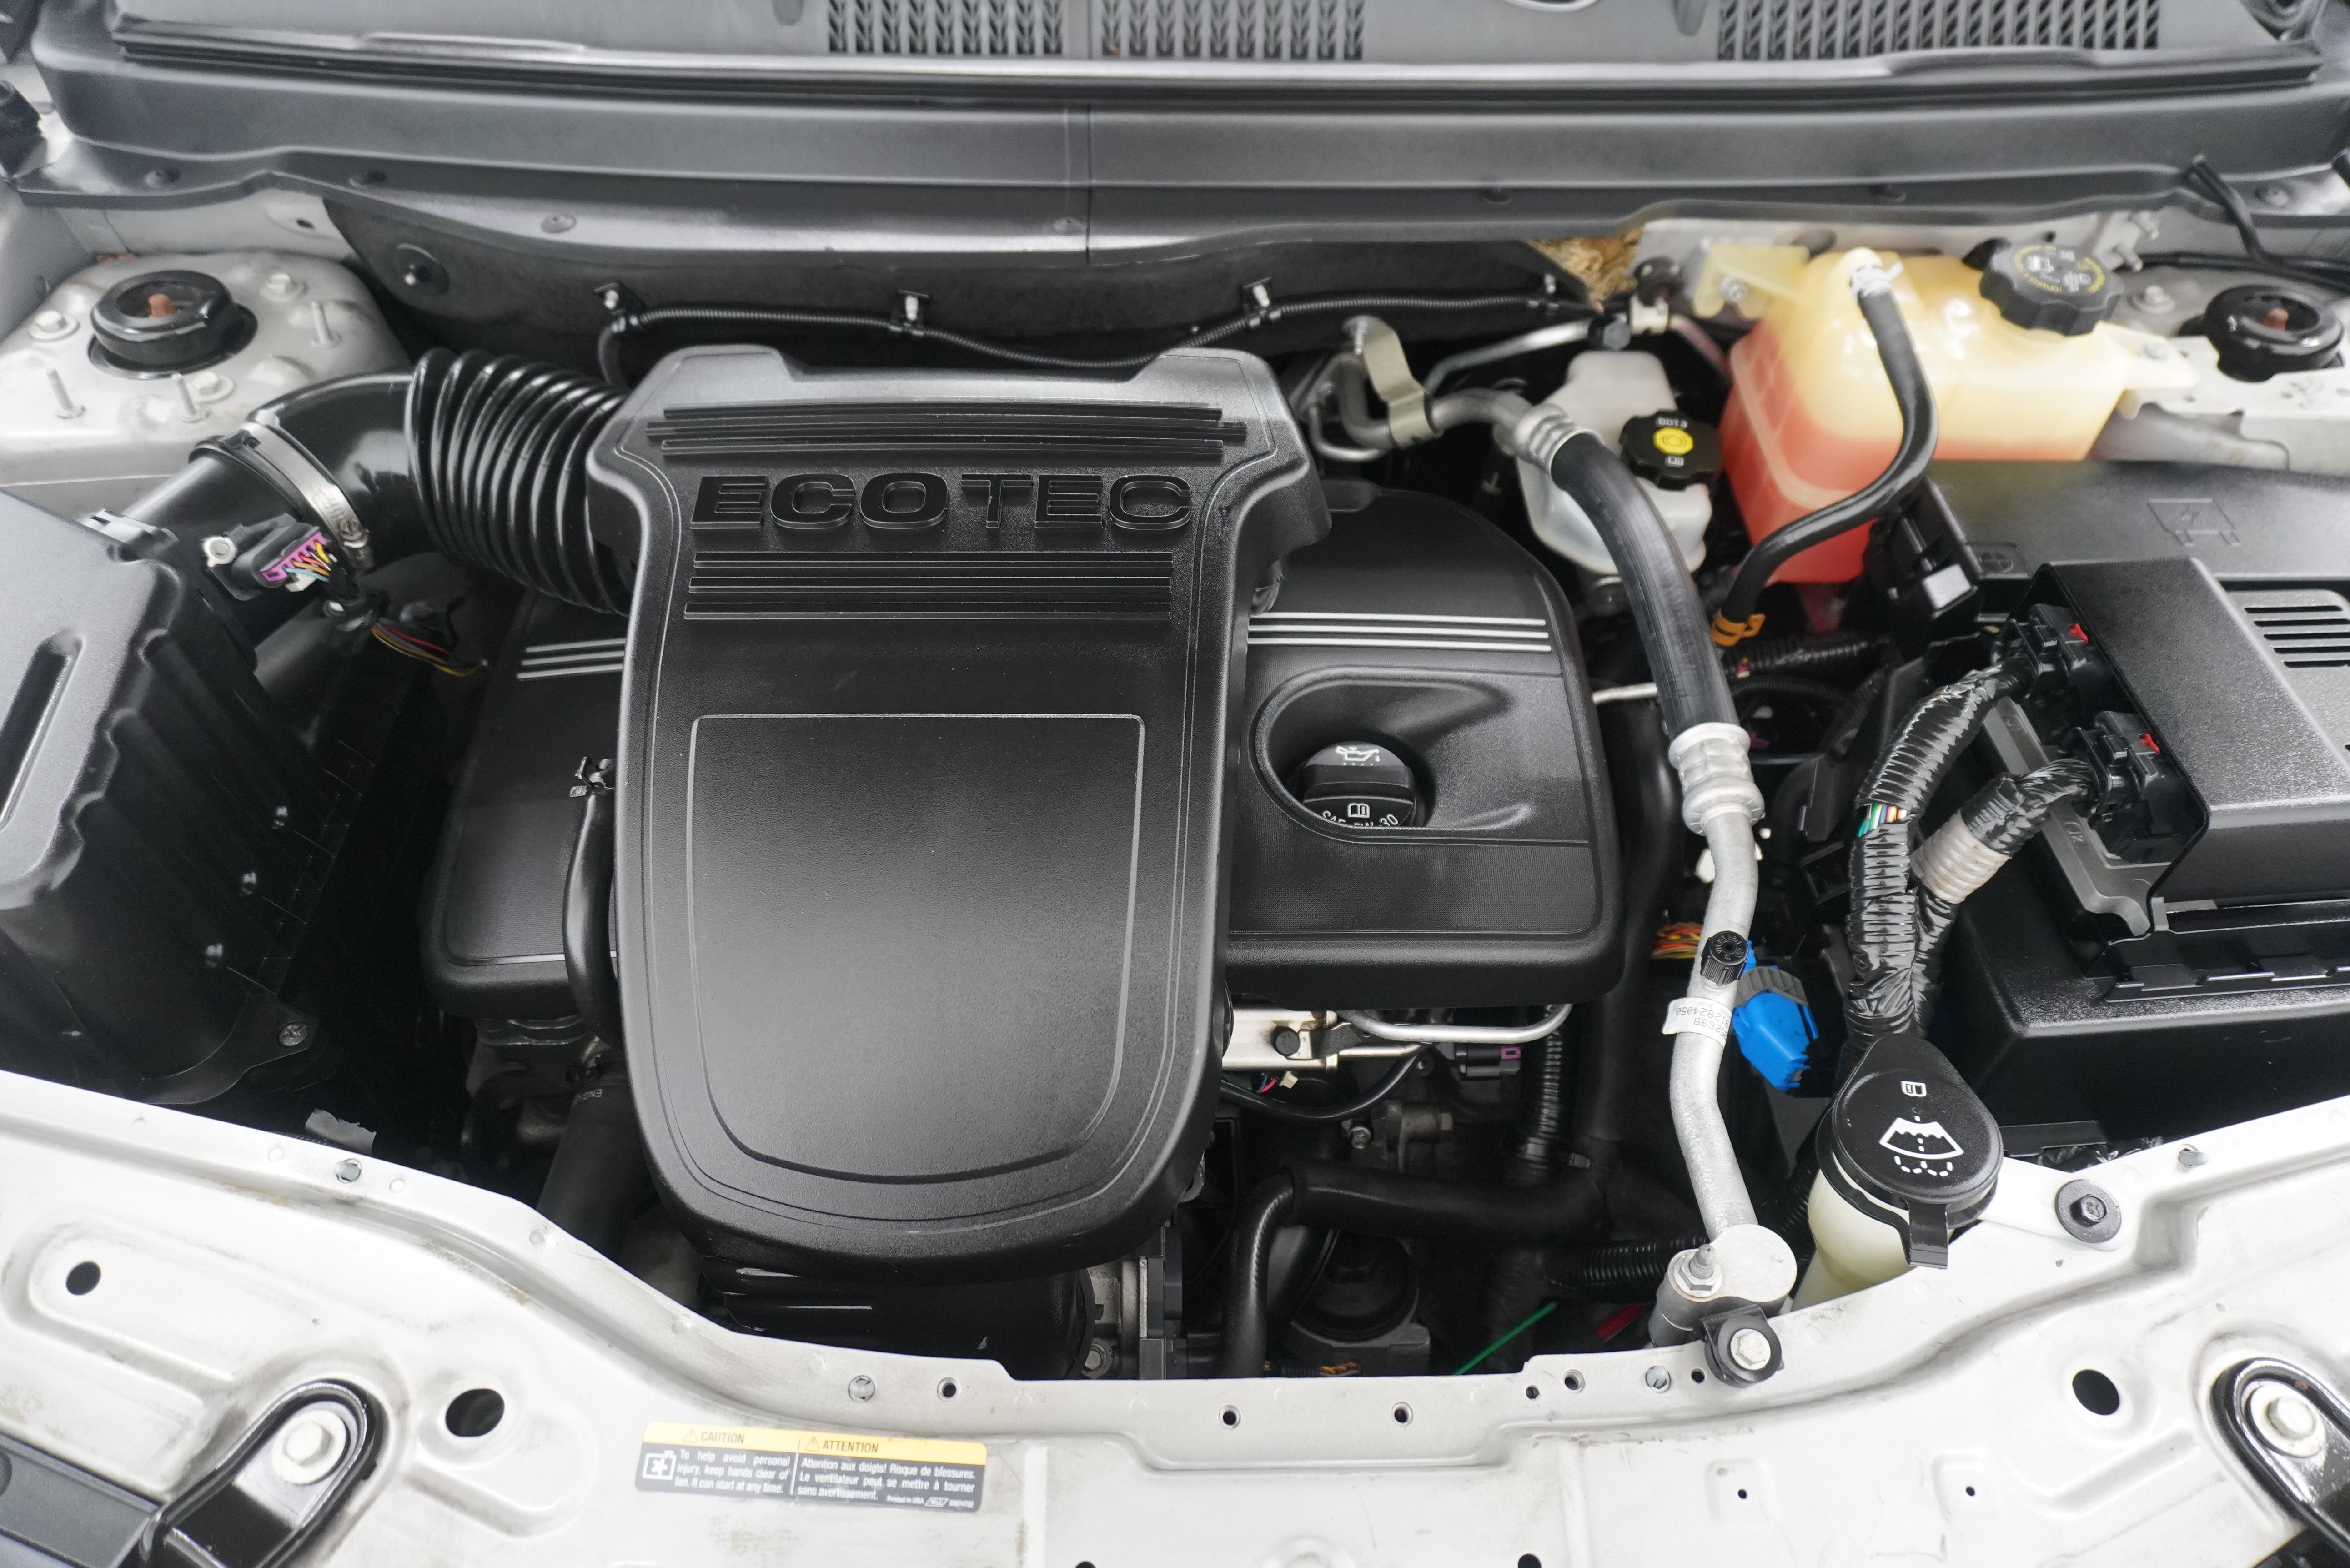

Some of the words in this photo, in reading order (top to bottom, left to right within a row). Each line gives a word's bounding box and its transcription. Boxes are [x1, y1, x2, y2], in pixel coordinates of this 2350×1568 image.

[690, 472, 1193, 531] ECOTEC
[701, 1431, 745, 1444] CAUTION
[823, 1440, 879, 1453] ATTENTION
[680, 1448, 690, 1460] To
[697, 1450, 715, 1463] help
[723, 1452, 747, 1464] avoid
[753, 1455, 790, 1467] personal
[677, 1462, 701, 1476] injury,
[704, 1464, 725, 1478] keep
[728, 1466, 753, 1478] hands
[755, 1468, 777, 1479] clear
[778, 1468, 790, 1480] of
[802, 1457, 838, 1470] Attention
[841, 1462, 857, 1472] aux
[859, 1461, 887, 1475] doigts!
[889, 1462, 918, 1477] Risque
[920, 1466, 932, 1477] de
[934, 1466, 976, 1479] blessures.
[691, 1477, 698, 1488] It
[698, 1479, 714, 1489] can
[715, 1479, 735, 1490] start
[736, 1480, 745, 1491] at
[746, 1482, 762, 1494] any
[763, 1482, 783, 1493] time.
[799, 1470, 811, 1482] Le
[814, 1473, 859, 1485] ventilateur
[863, 1476, 883, 1488] peut
[887, 1478, 897, 1488] se
[901, 1479, 930, 1490] mettre
[933, 1478, 940, 1491] à
[944, 1480, 975, 1493] tourner
[797, 1486, 817, 1496] sans
[819, 1487, 878, 1500] avertissement.
[886, 1494, 906, 1503] Printed
[912, 1496, 924, 1504] USA
